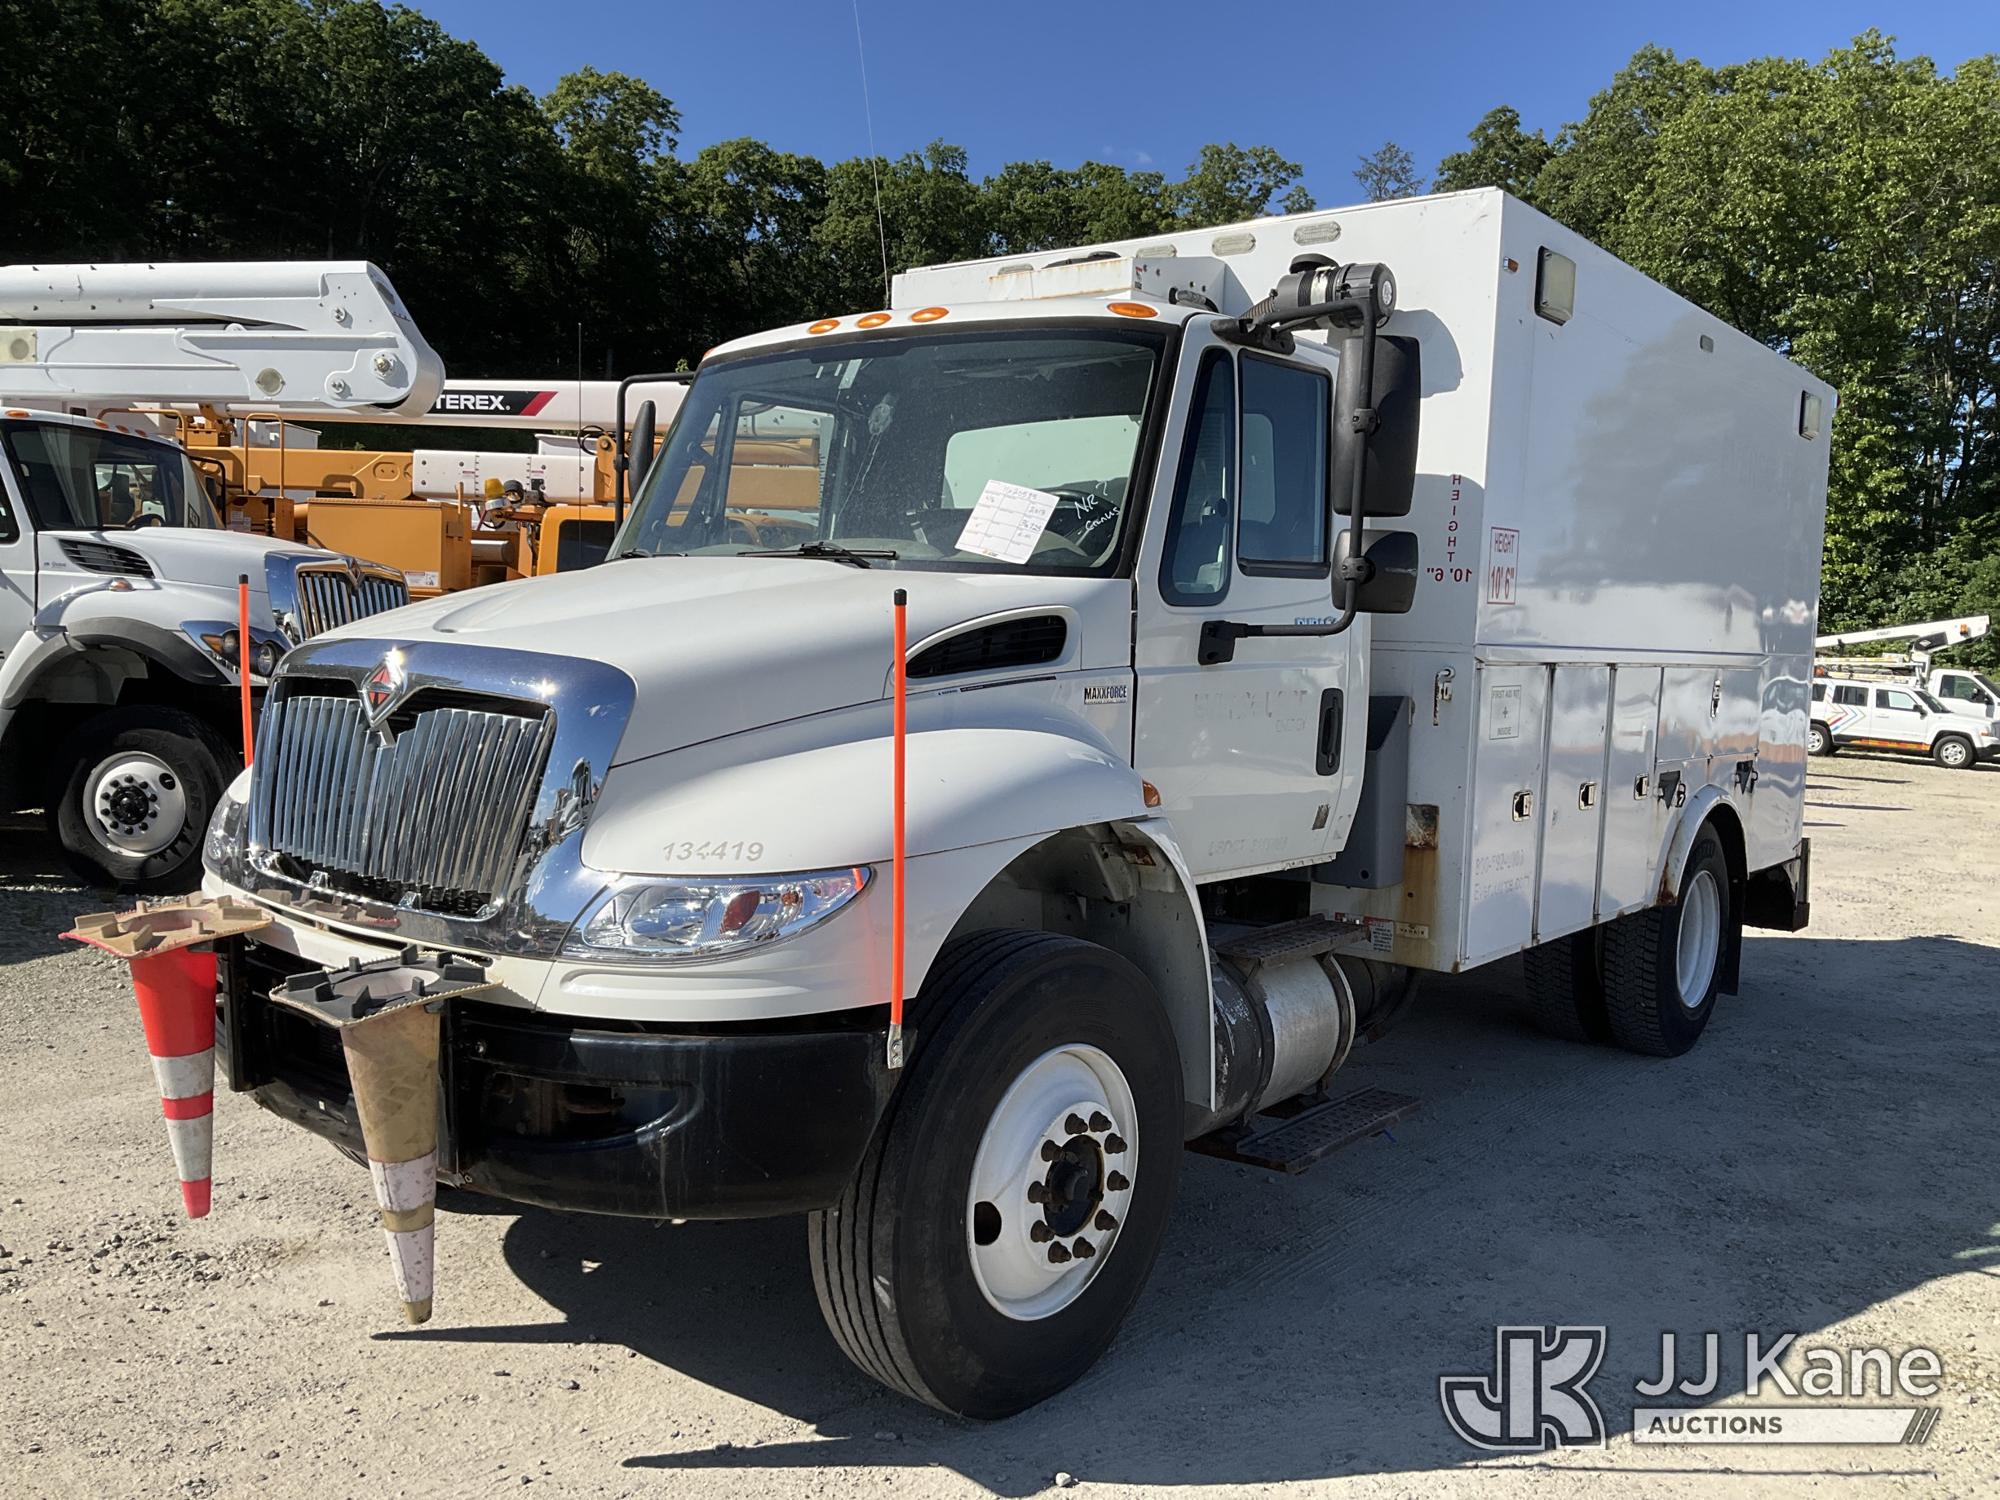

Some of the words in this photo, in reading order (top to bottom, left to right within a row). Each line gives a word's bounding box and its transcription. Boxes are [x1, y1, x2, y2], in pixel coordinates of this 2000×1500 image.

[436, 394, 506, 411] TEREX
[1494, 532, 1515, 554] HEIGHT
[1084, 685, 1127, 700] MAXXFORCE
